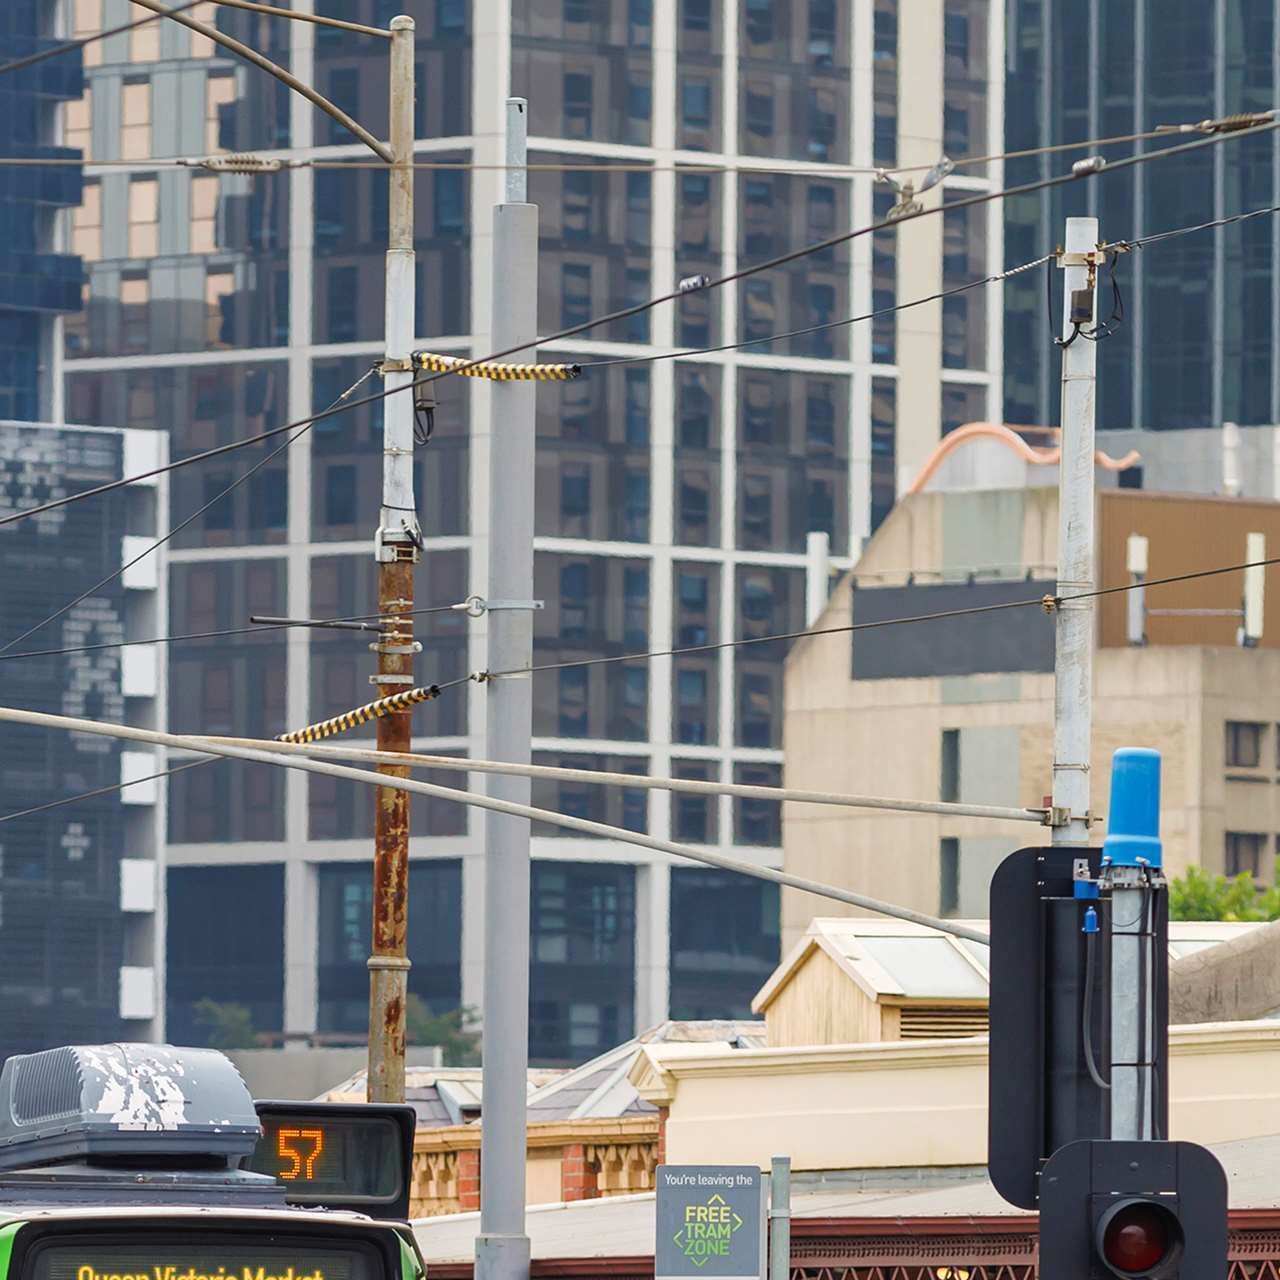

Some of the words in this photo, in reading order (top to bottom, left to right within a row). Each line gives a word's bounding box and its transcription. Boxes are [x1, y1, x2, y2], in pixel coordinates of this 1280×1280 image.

[278, 1129, 324, 1180] 57
[665, 1174, 696, 1186] You're
[698, 1174, 735, 1188] leaving
[736, 1174, 753, 1185] the
[685, 1206, 731, 1222] FREE
[684, 1223, 731, 1238] TRAM
[683, 1239, 730, 1255] ZONE
